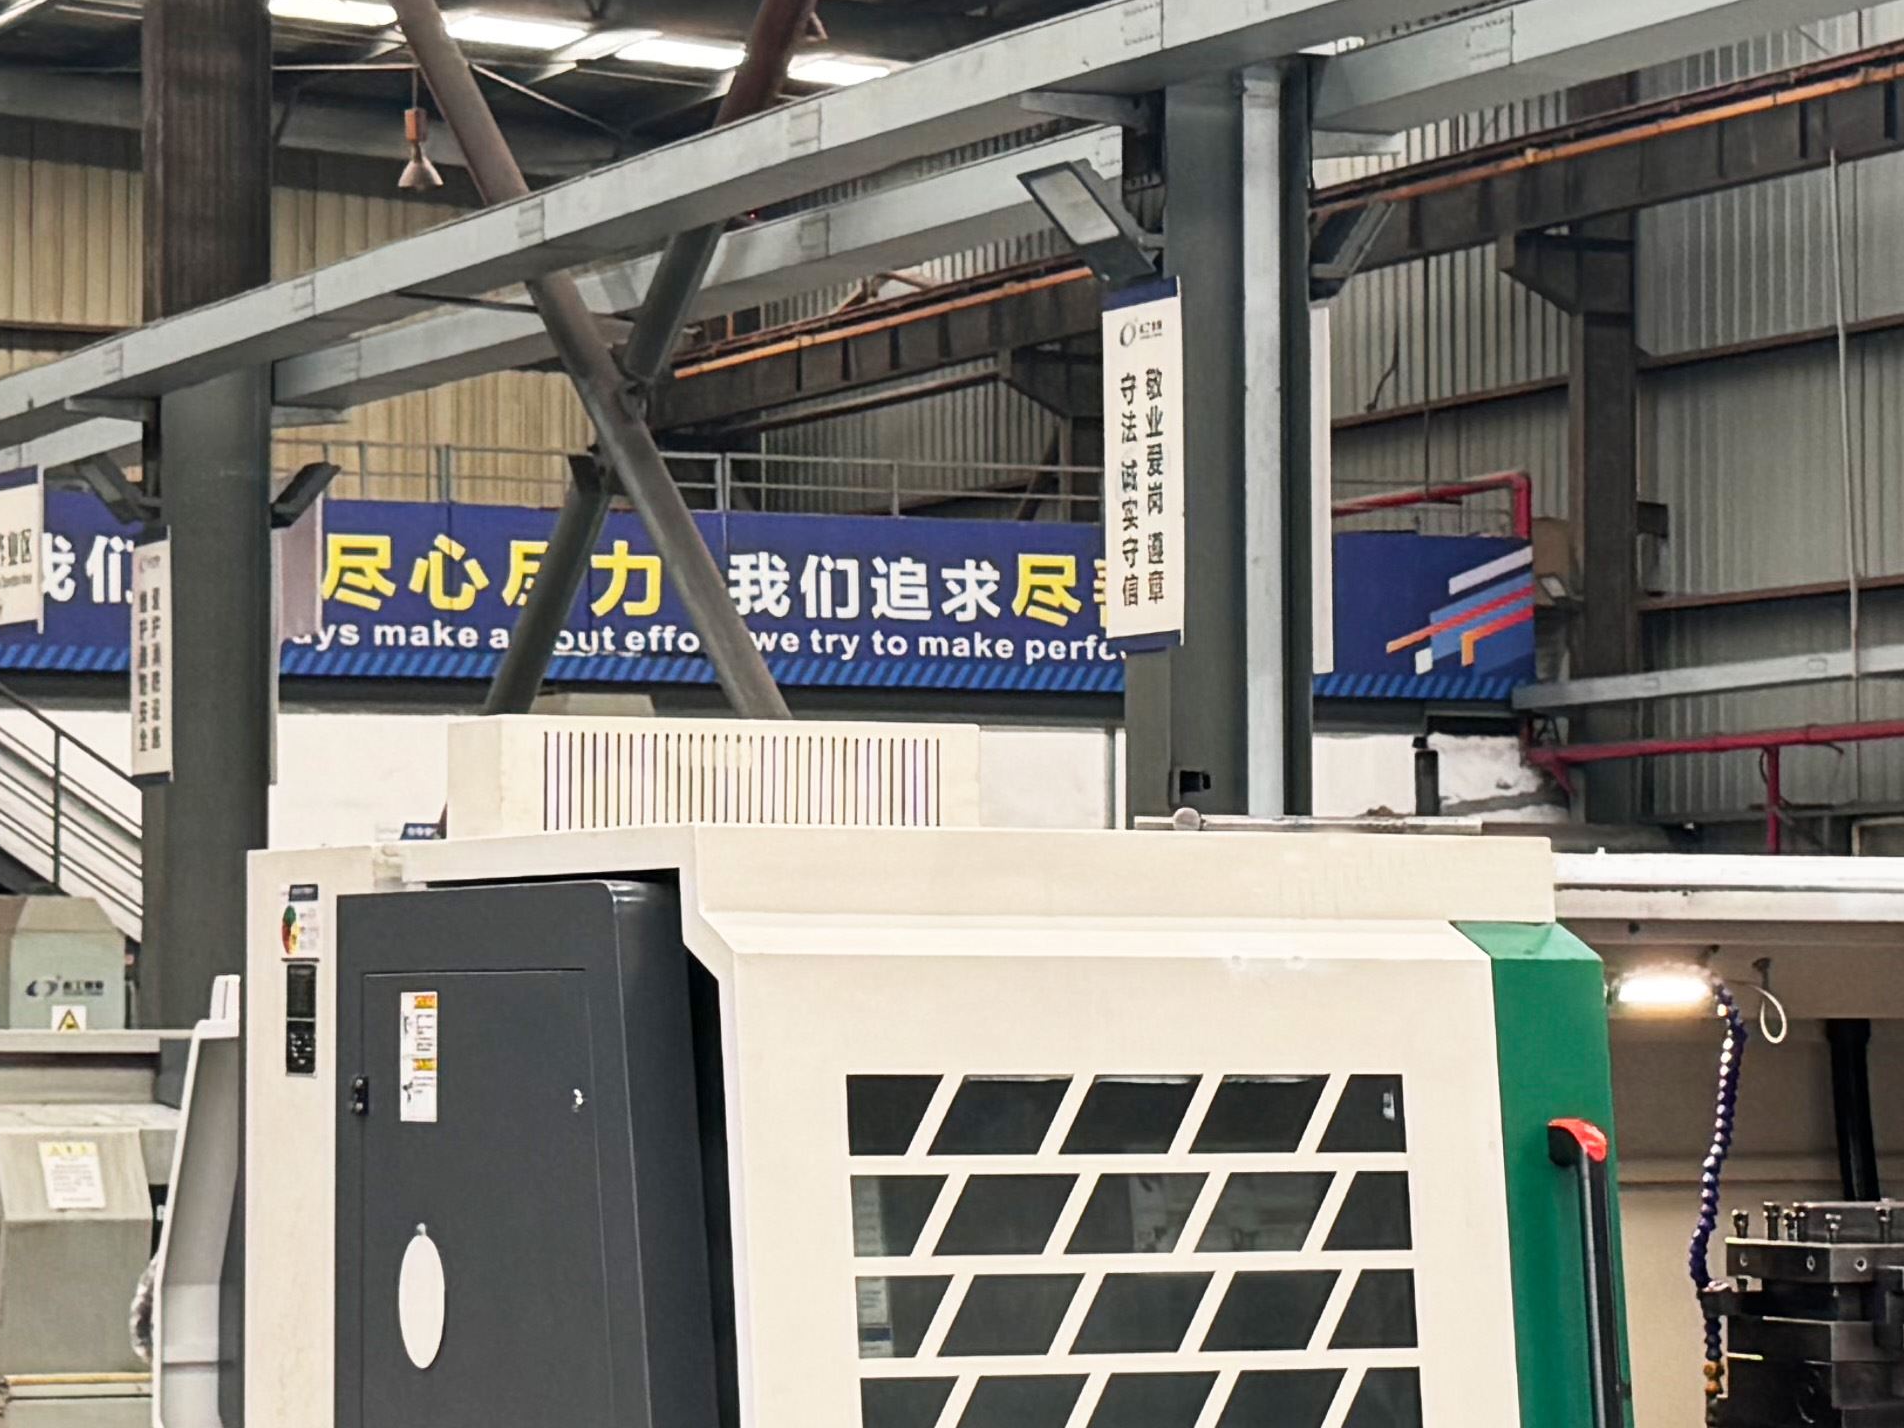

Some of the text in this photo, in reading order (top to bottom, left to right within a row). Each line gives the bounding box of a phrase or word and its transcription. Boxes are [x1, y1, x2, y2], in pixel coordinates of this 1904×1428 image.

[1120, 372, 1138, 444] 守法
[1145, 367, 1164, 515] 敬业爱岗
[727, 552, 1106, 627] 我们追求尽
[373, 619, 479, 649] make
[624, 624, 701, 653] effo
[811, 630, 862, 661] try
[873, 632, 909, 656] to
[918, 633, 1015, 659] make
